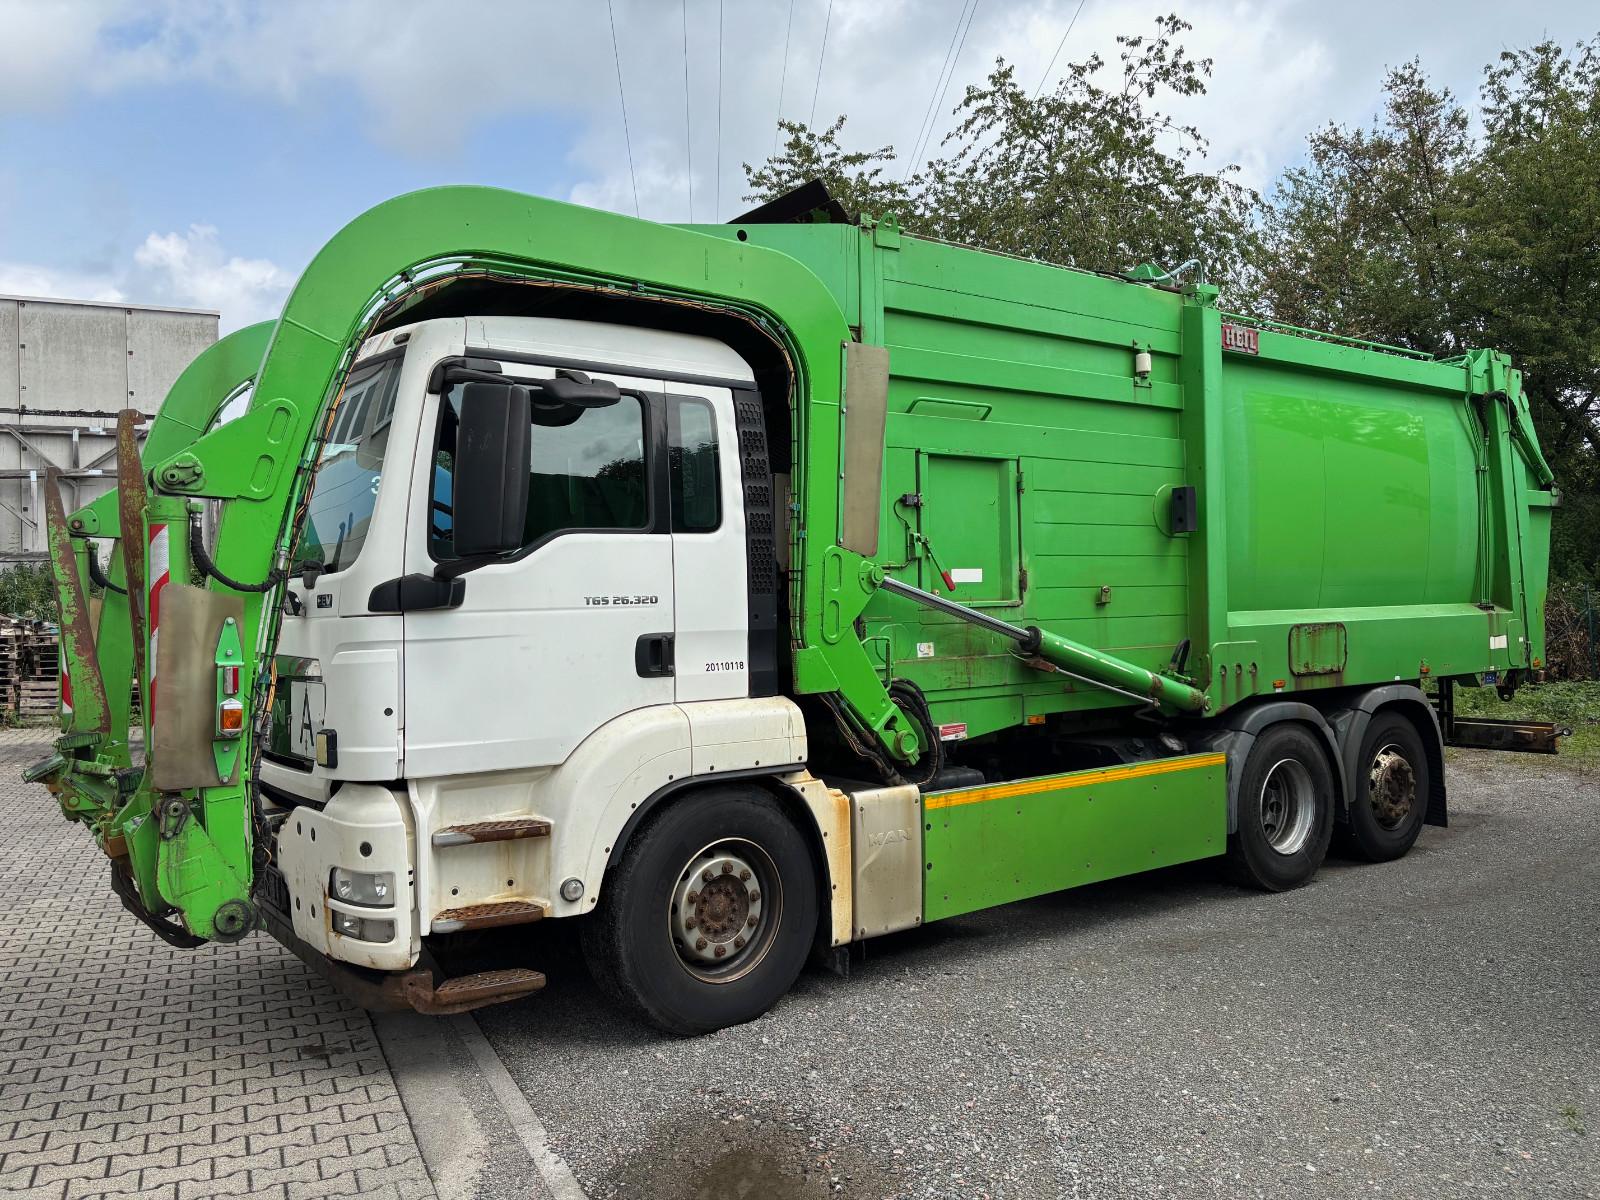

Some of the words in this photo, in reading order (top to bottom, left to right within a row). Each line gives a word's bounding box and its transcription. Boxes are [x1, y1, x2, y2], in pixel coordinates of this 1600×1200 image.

[1225, 328, 1256, 350] HEIL
[584, 596, 609, 606] TGS
[613, 595, 659, 605] 26.320
[705, 661, 744, 672] 20110118
[300, 687, 314, 747] A
[868, 829, 912, 848] MAN
